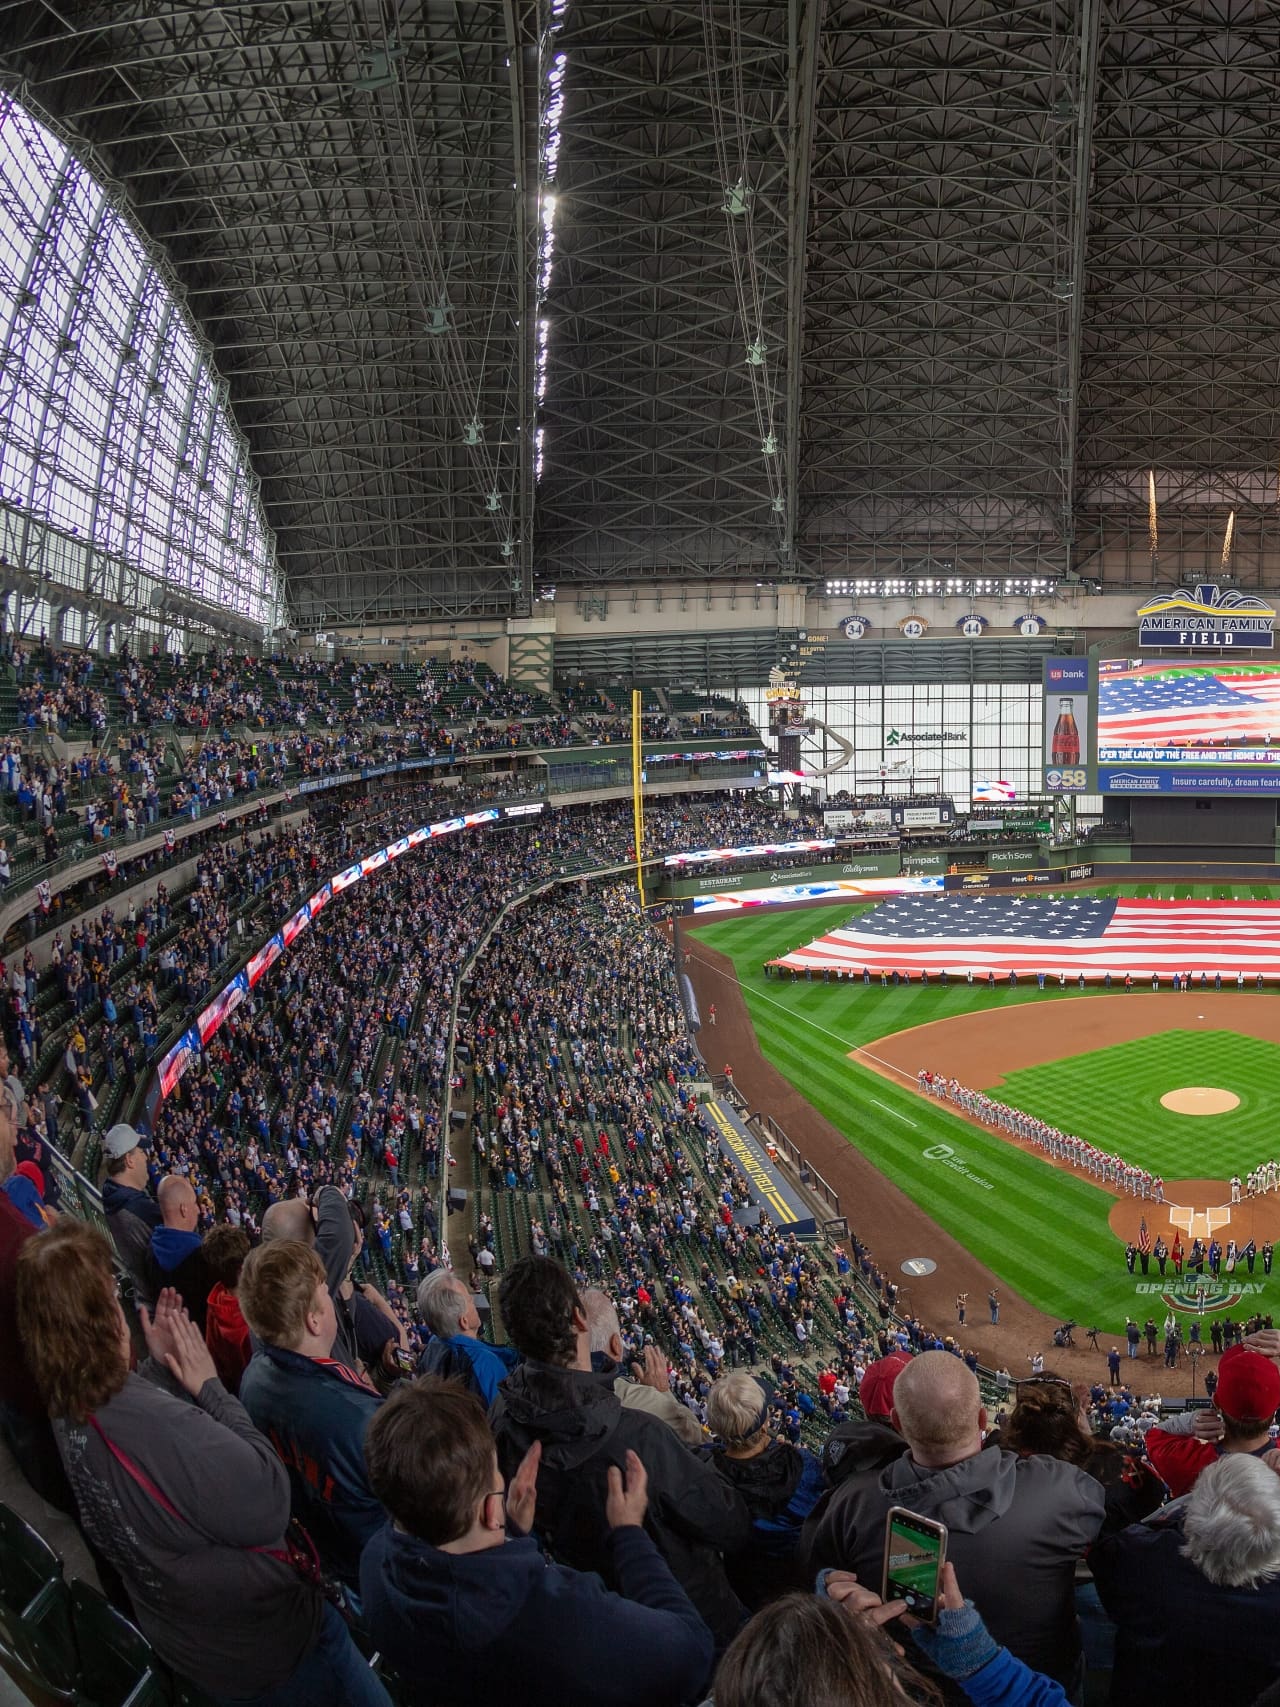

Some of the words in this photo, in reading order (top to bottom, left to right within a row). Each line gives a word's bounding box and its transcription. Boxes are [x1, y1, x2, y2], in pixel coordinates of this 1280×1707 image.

[848, 624, 862, 635] 34
[906, 624, 920, 634] 42
[964, 623, 979, 634] 44
[1028, 623, 1033, 633] 1
[1141, 618, 1215, 630] AMERICAN
[1221, 619, 1273, 630] FAMILY
[1180, 632, 1233, 645] FIELD
[1063, 670, 1084, 678] bank
[1119, 751, 1133, 759] THE
[1166, 751, 1180, 759] THE
[1181, 751, 1199, 759] FREE
[1200, 751, 1217, 760] AND
[1217, 752, 1233, 760] THE
[1233, 752, 1256, 760] HOME
[1256, 752, 1266, 760] OF
[1061, 770, 1087, 787] 58
[1172, 777, 1197, 786] Insure
[1198, 777, 1234, 788] carefully,
[1234, 778, 1259, 786] dream
[909, 855, 940, 865] impact
[842, 864, 863, 874] Bally
[1070, 866, 1092, 879] meijer
[717, 1122, 748, 1155] AMERICAN
[737, 1150, 764, 1174] FAMILY
[751, 1172, 777, 1193] FIELD
[942, 1159, 970, 1174] credit
[966, 1173, 995, 1190] union
[1228, 1283, 1266, 1294] DAY
